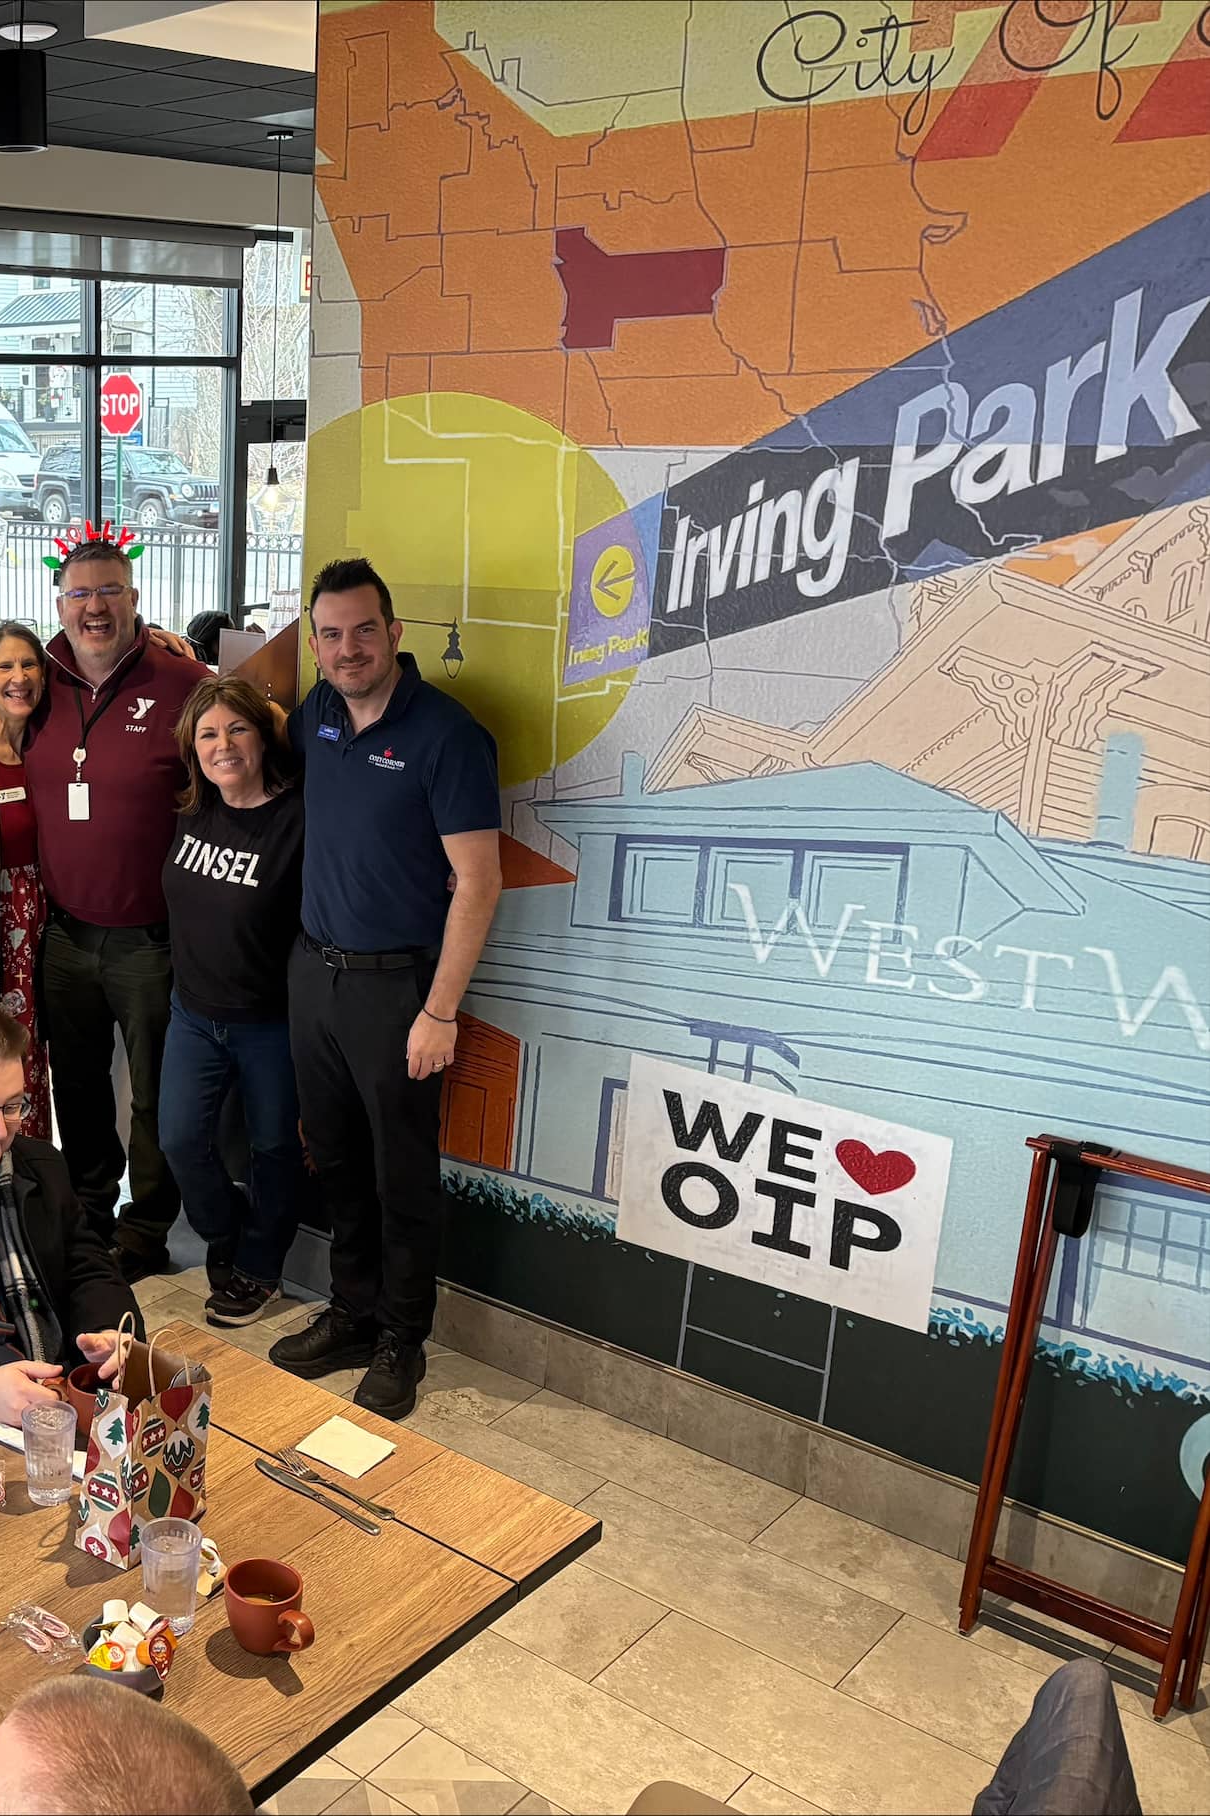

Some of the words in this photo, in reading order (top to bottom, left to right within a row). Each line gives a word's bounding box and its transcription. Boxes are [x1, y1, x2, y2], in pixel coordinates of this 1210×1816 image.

[756, 10, 955, 135] City
[101, 393, 139, 417] STOP
[665, 457, 861, 614] Irving
[881, 286, 1210, 539] Park
[54, 519, 136, 556] JOLLY
[568, 642, 607, 667] Irving
[607, 626, 650, 657] Park
[125, 724, 148, 733] STAFF
[173, 833, 260, 888] TINSEL
[662, 1088, 823, 1184] WE
[660, 1161, 902, 1271] OIP
